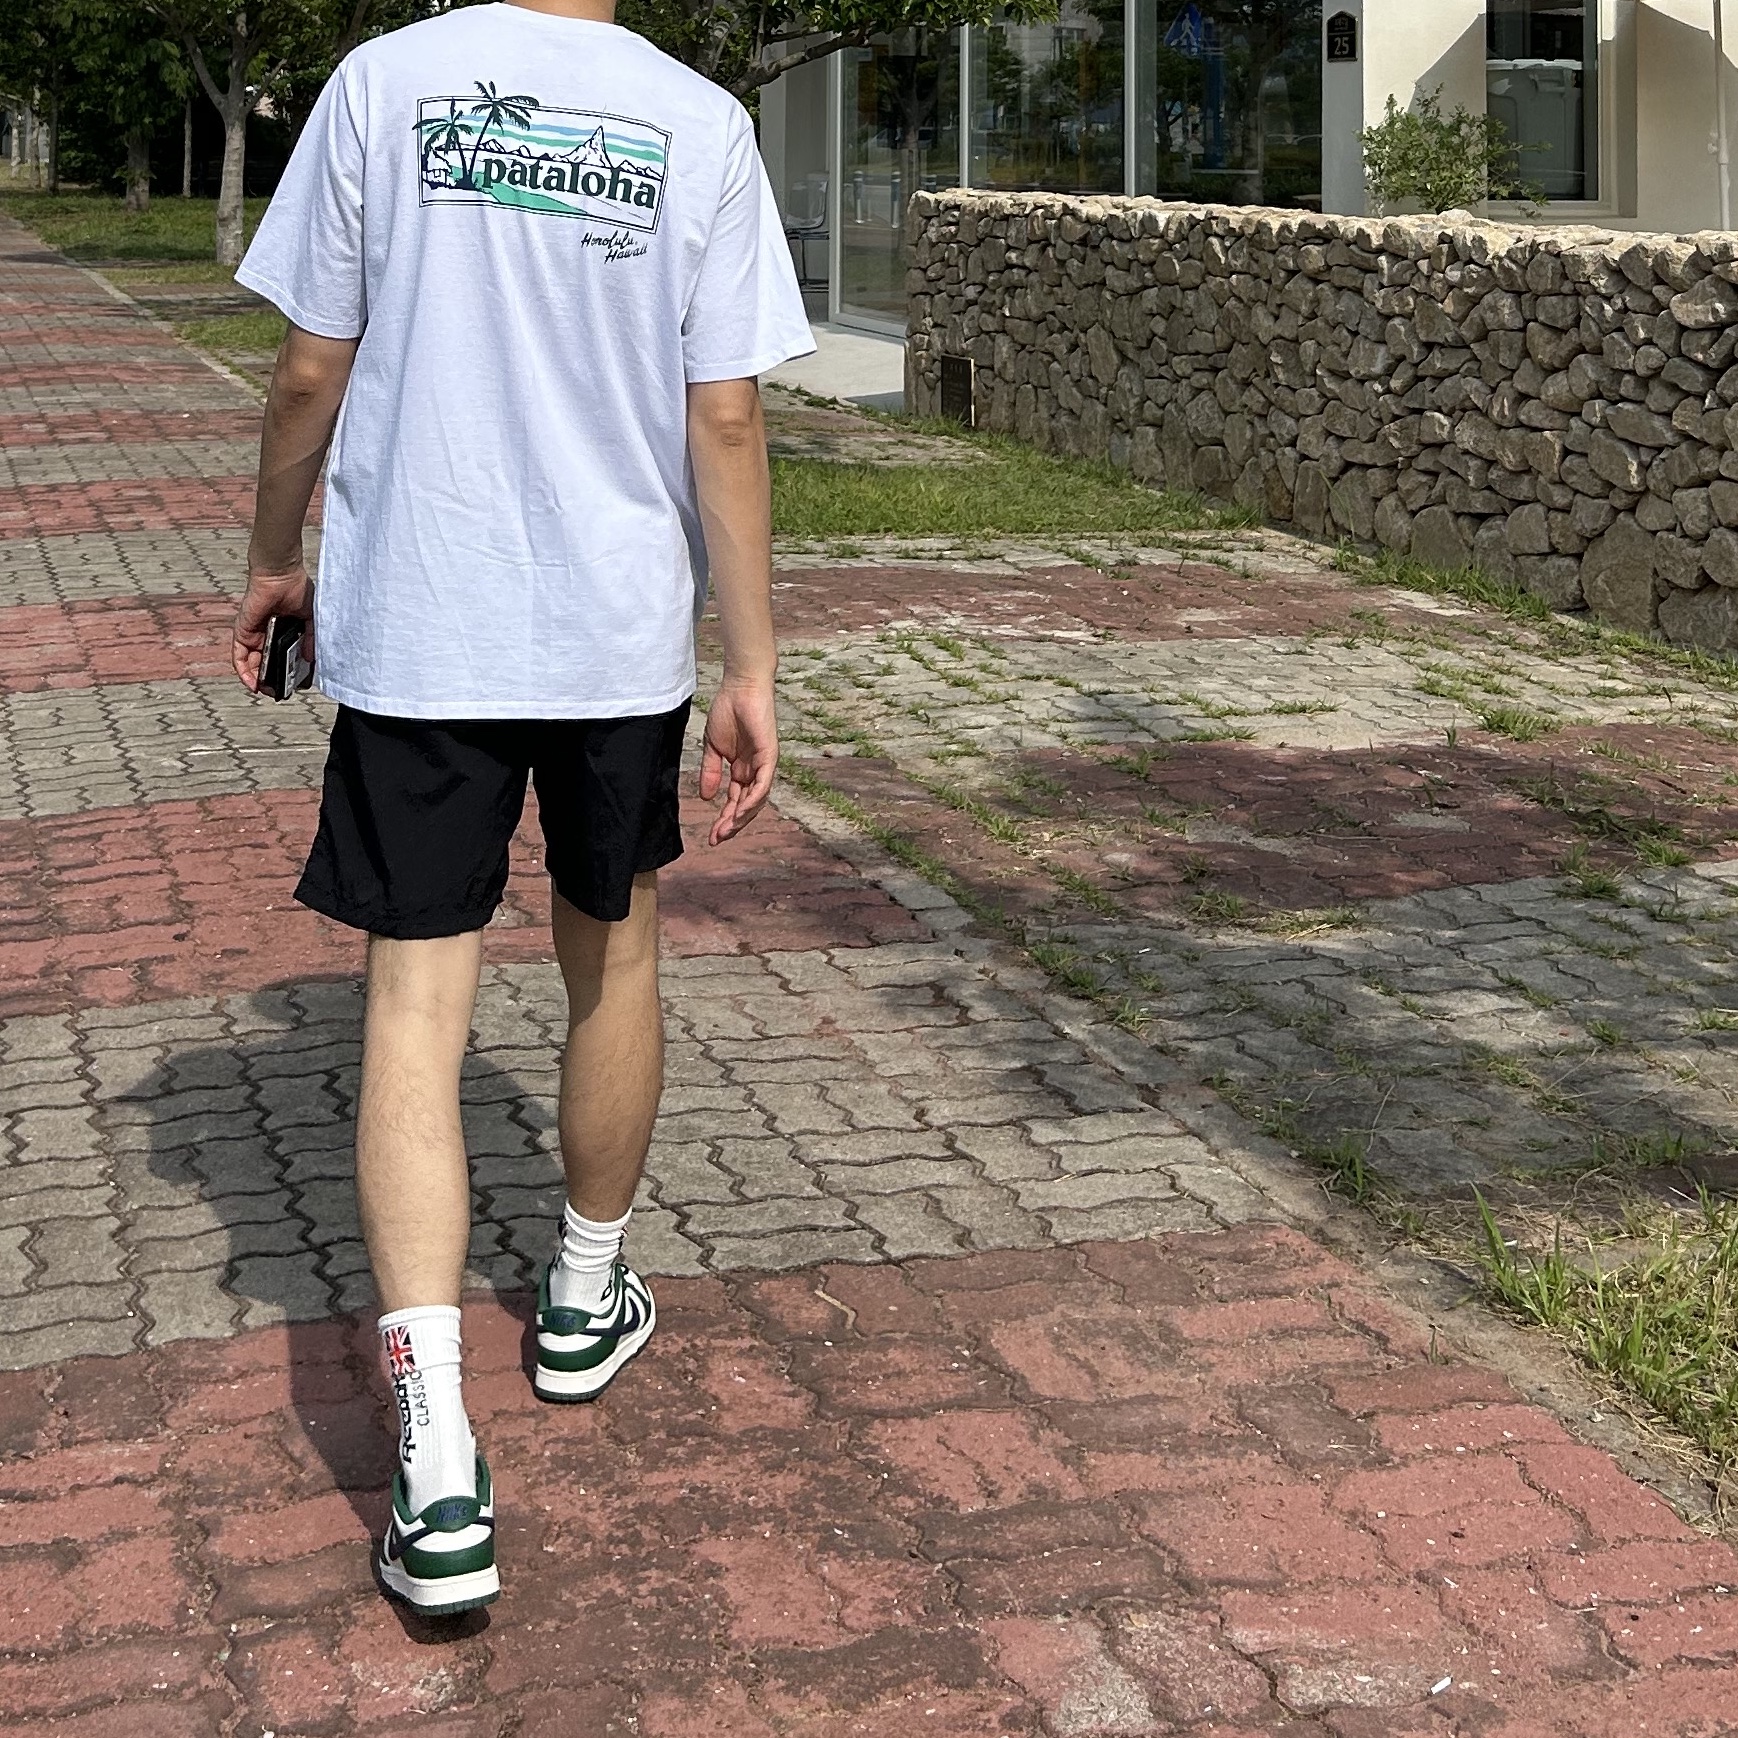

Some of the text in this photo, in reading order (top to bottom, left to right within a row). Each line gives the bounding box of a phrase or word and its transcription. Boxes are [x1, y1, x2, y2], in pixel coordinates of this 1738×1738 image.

[1334, 37, 1350, 56] 25
[482, 157, 656, 209] pataloha
[410, 1370, 430, 1427] CLASSIC
